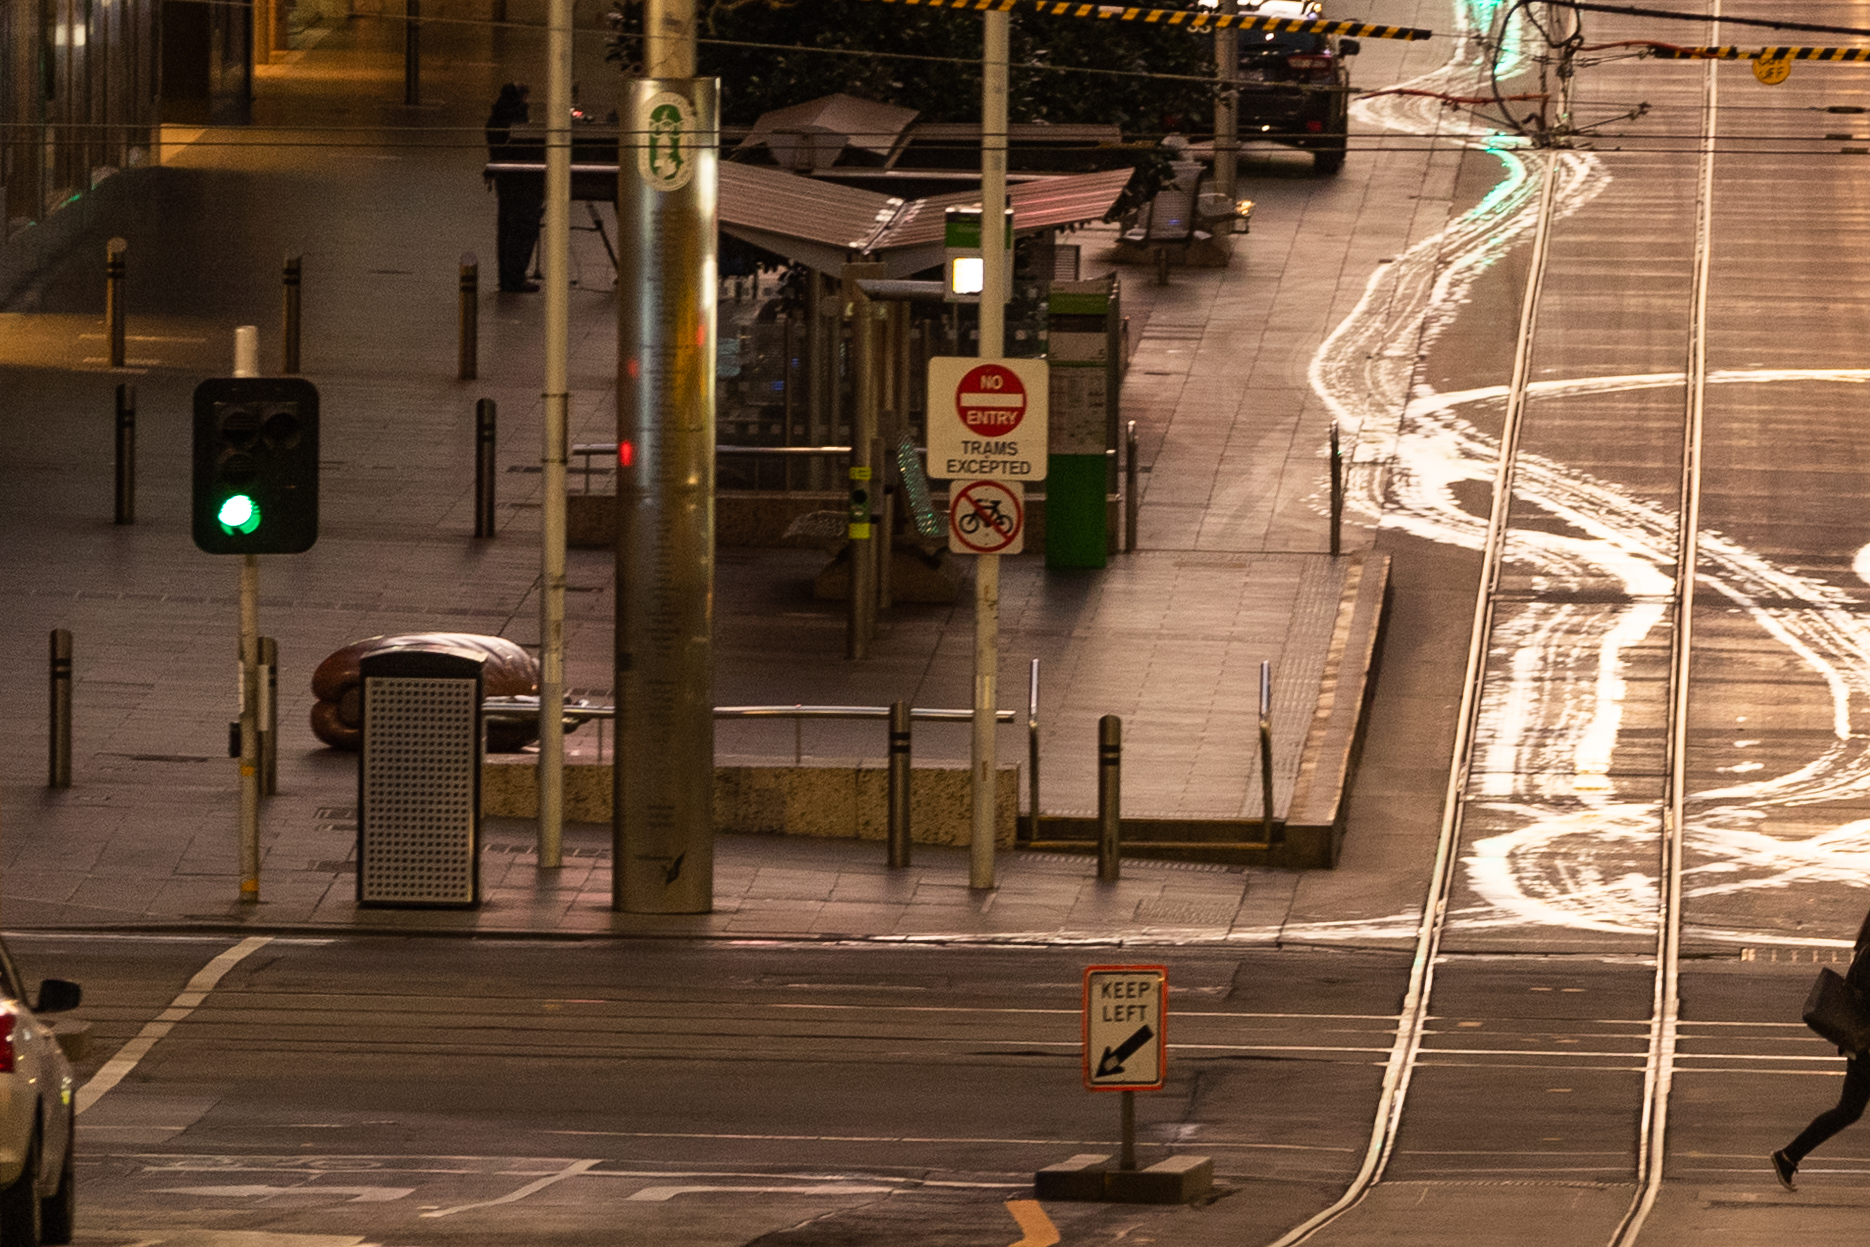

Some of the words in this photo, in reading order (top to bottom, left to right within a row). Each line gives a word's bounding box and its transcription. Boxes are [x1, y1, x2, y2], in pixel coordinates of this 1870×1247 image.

[980, 374, 1004, 390] NO
[966, 410, 1019, 425] ENTRY
[962, 440, 1019, 456] TRAMS
[946, 458, 1032, 475] EXCEPTED
[1101, 981, 1151, 999] KEEP
[1102, 1004, 1148, 1022] LEFT
